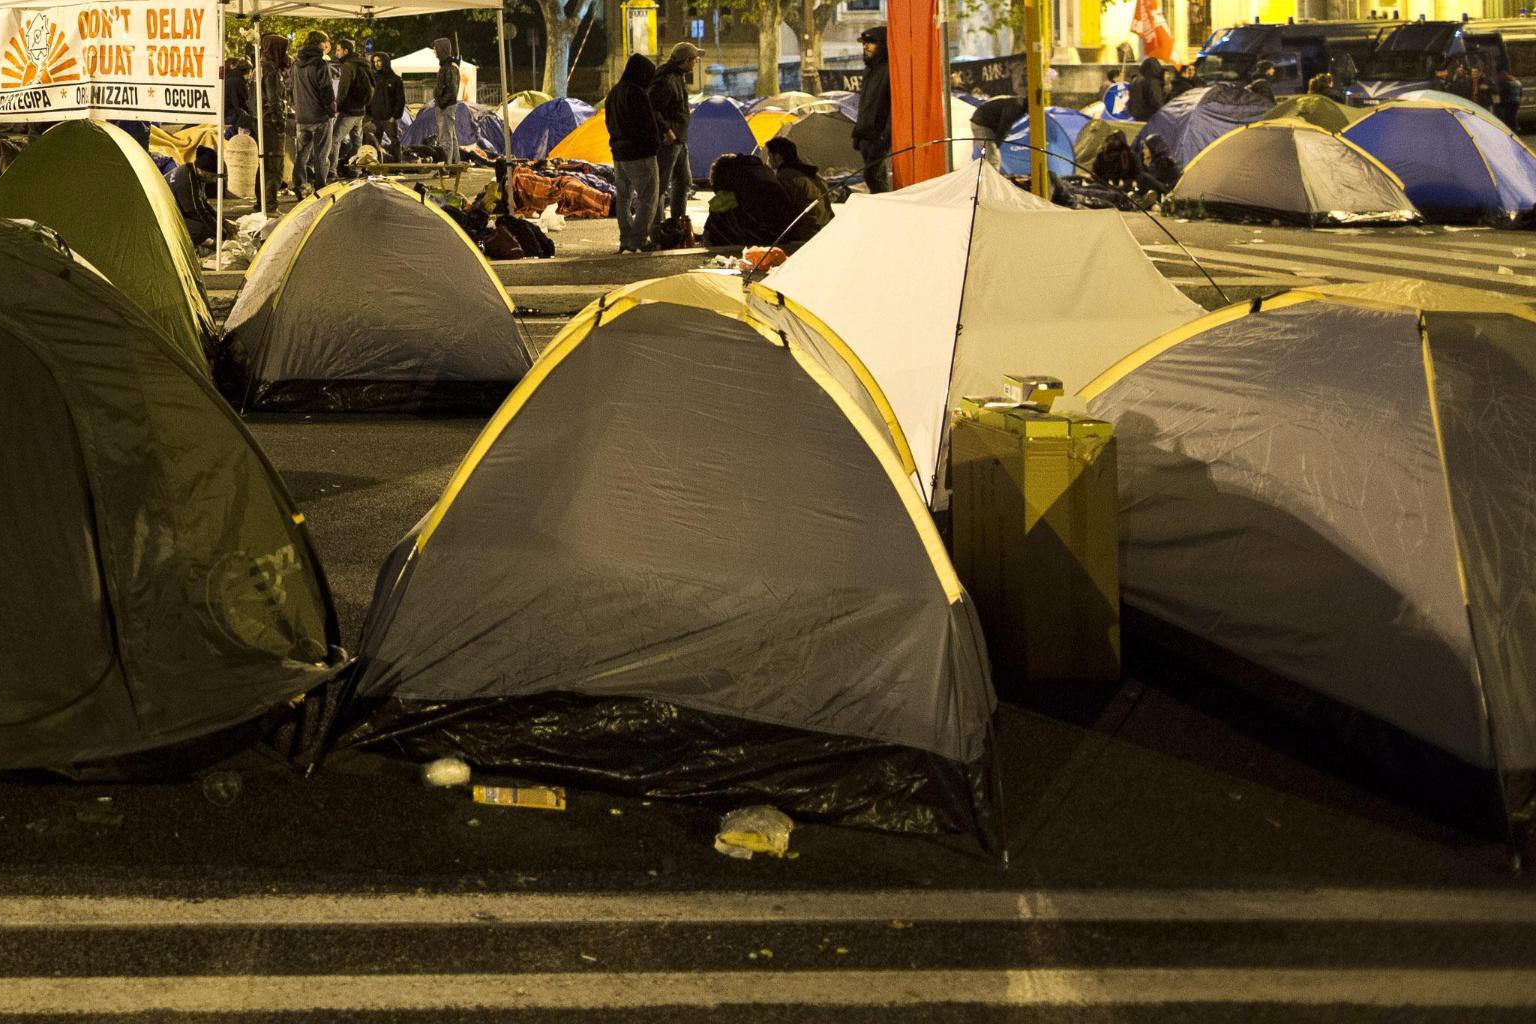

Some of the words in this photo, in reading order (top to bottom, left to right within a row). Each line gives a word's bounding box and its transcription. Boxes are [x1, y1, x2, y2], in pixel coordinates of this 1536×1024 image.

[77, 6, 131, 40] DON'T
[146, 8, 204, 40] DELAY
[146, 45, 205, 78] TODAY
[164, 87, 211, 109] OCCUPA
